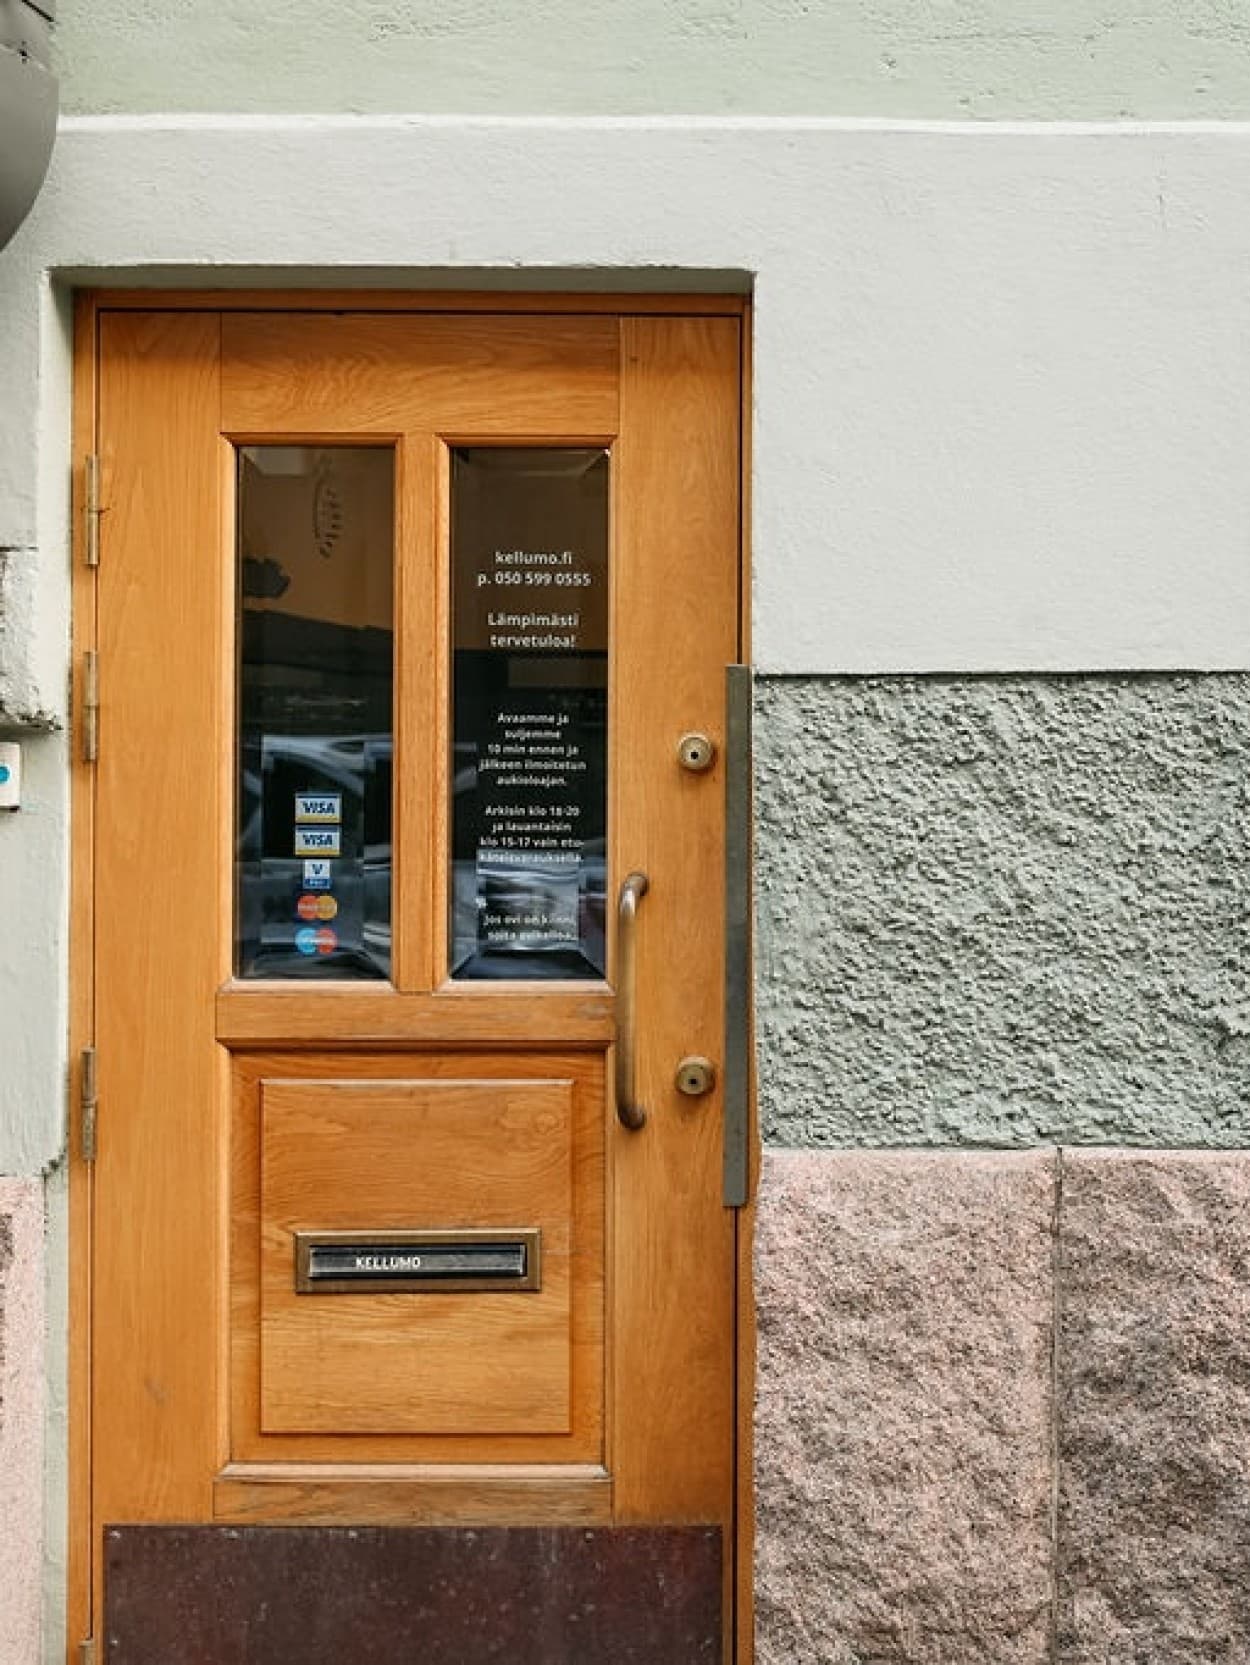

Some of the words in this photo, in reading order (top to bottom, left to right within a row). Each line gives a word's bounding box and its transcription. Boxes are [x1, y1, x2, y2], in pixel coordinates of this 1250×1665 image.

[495, 552, 572, 565] kellumo.fi
[477, 573, 491, 587] p.
[495, 571, 521, 585] 050
[525, 572, 552, 586] 599
[554, 573, 591, 586] 0555
[487, 612, 579, 629] Lämpimästi
[490, 634, 575, 648] tervetuloa!
[557, 713, 570, 726] ja
[302, 801, 336, 814] VISA
[302, 834, 333, 846] VISA
[354, 1255, 422, 1270] KELLUMO
